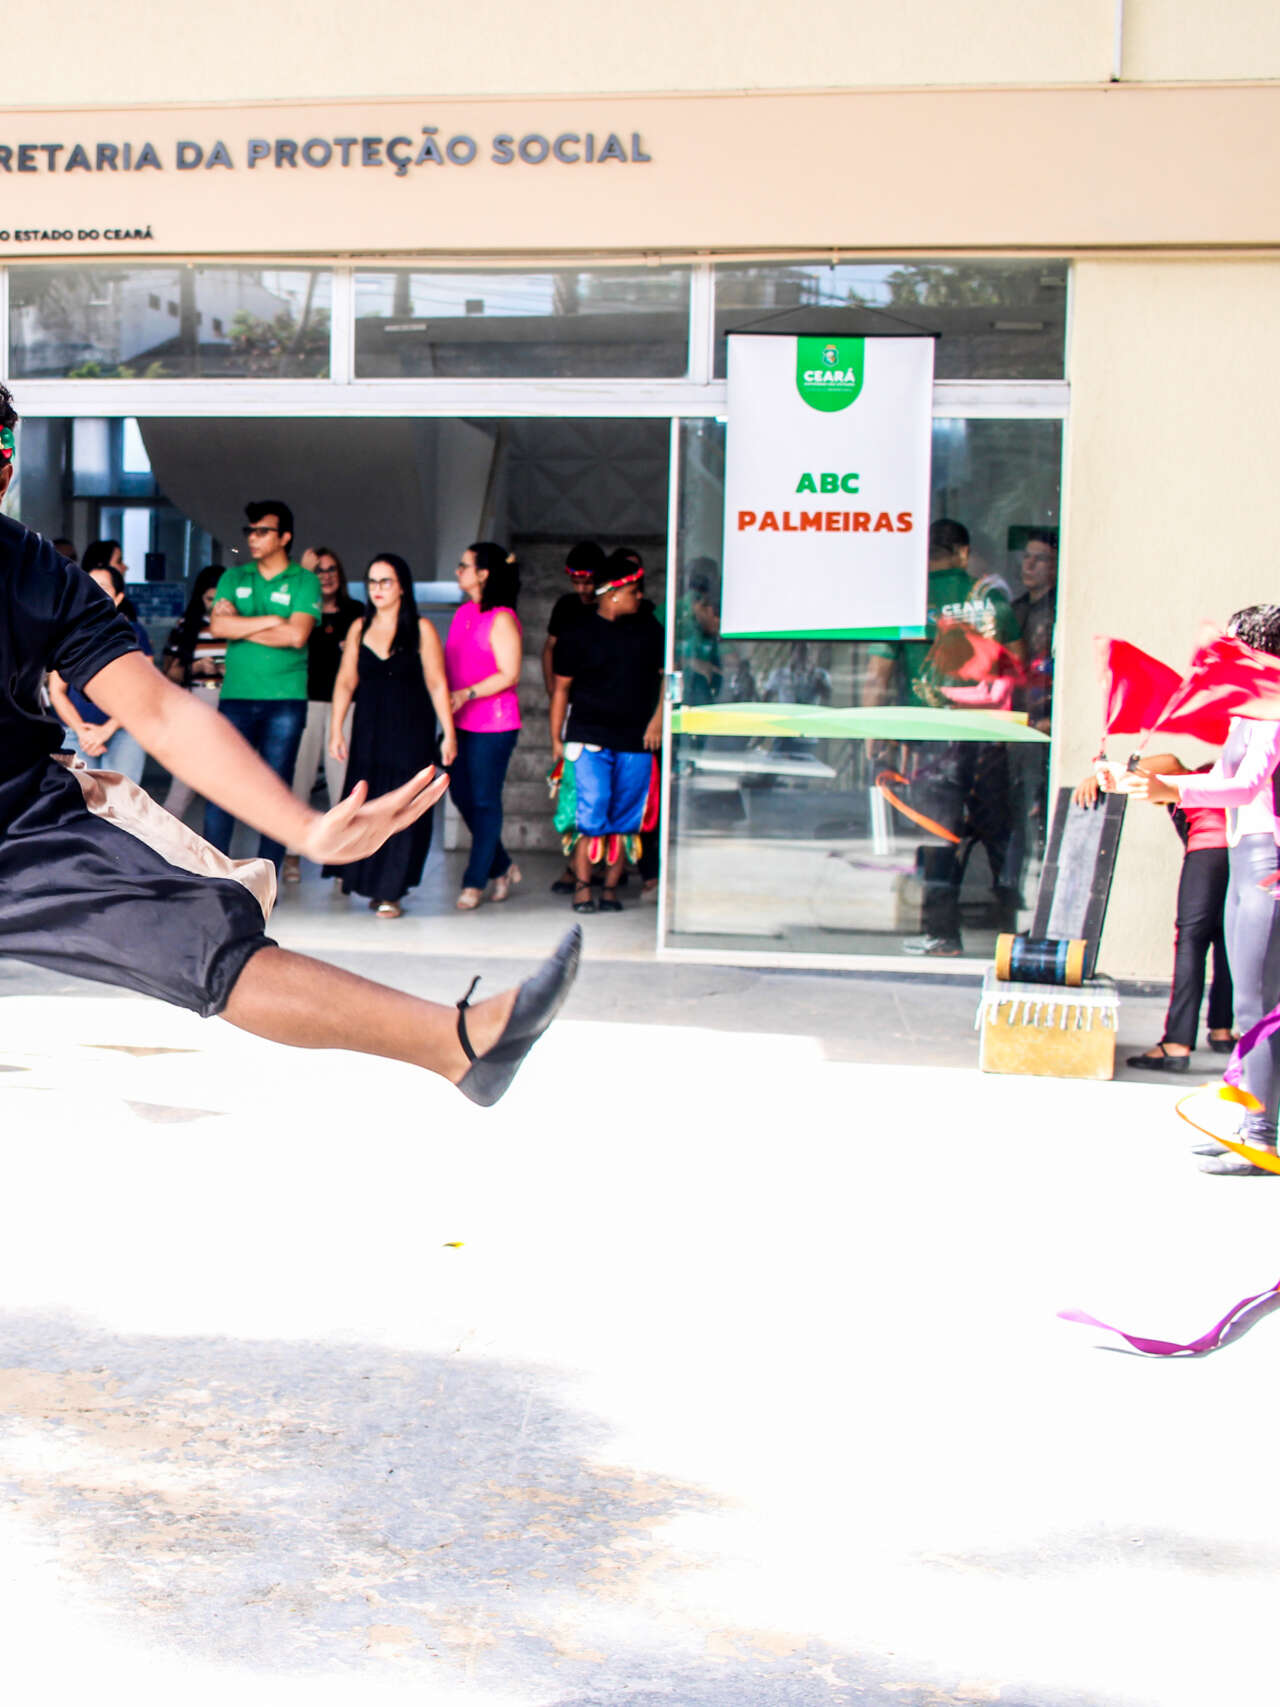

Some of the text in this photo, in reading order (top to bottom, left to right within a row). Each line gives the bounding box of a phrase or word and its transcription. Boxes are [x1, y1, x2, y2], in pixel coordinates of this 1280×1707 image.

[176, 140, 234, 170] DA
[247, 126, 477, 176] PROTEÇÃO
[492, 132, 652, 165] SOCIAL
[14, 229, 73, 242] ESTADO
[77, 229, 99, 241] DO
[104, 225, 153, 241] CEARÁ
[803, 367, 856, 382] CEARÁ
[795, 472, 860, 494] ABC
[737, 511, 913, 532] PALMEIRAS
